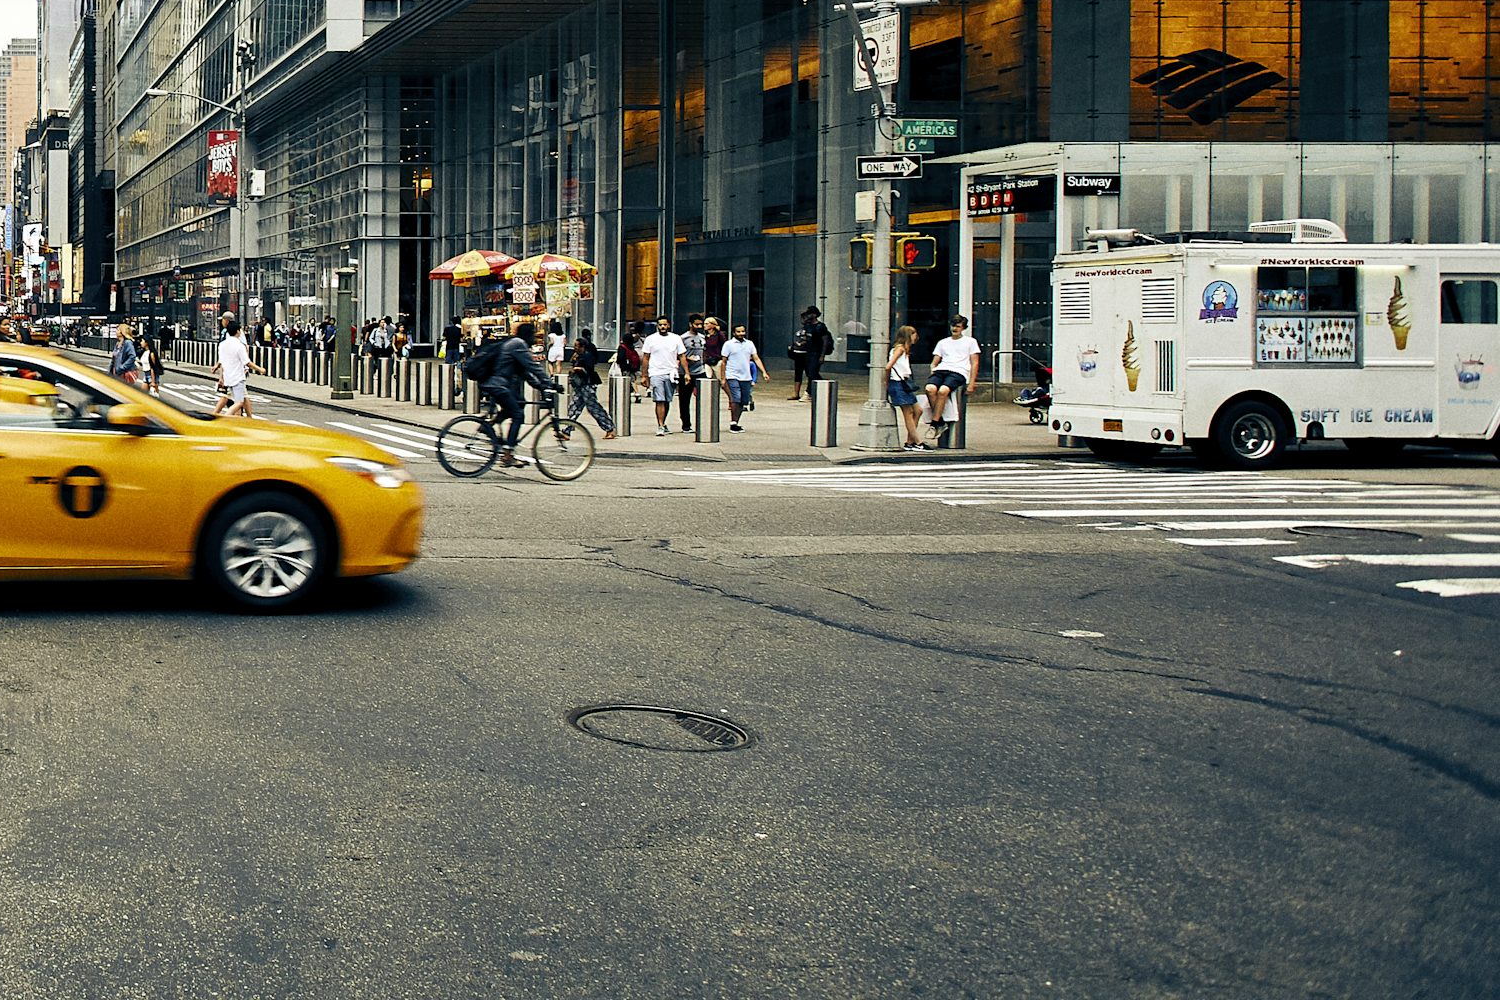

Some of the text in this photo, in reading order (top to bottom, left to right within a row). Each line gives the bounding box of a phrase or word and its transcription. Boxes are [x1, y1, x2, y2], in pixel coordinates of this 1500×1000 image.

[905, 125, 955, 135] AMERICAS
[907, 138, 917, 151] 6
[208, 143, 237, 160] JERSEY
[212, 158, 233, 173] BOYS
[866, 162, 912, 173] ONE WAY
[967, 186, 975, 194] 42
[1002, 181, 1016, 190] Park
[1017, 179, 1039, 188] Station
[1067, 175, 1112, 189] Subway
[970, 193, 1011, 206] B D F M
[1260, 258, 1365, 266] #NewYorkIceCream
[1075, 267, 1153, 277] #NewYorkIceCream
[1299, 408, 1434, 423] SOFT ICE CREAM
